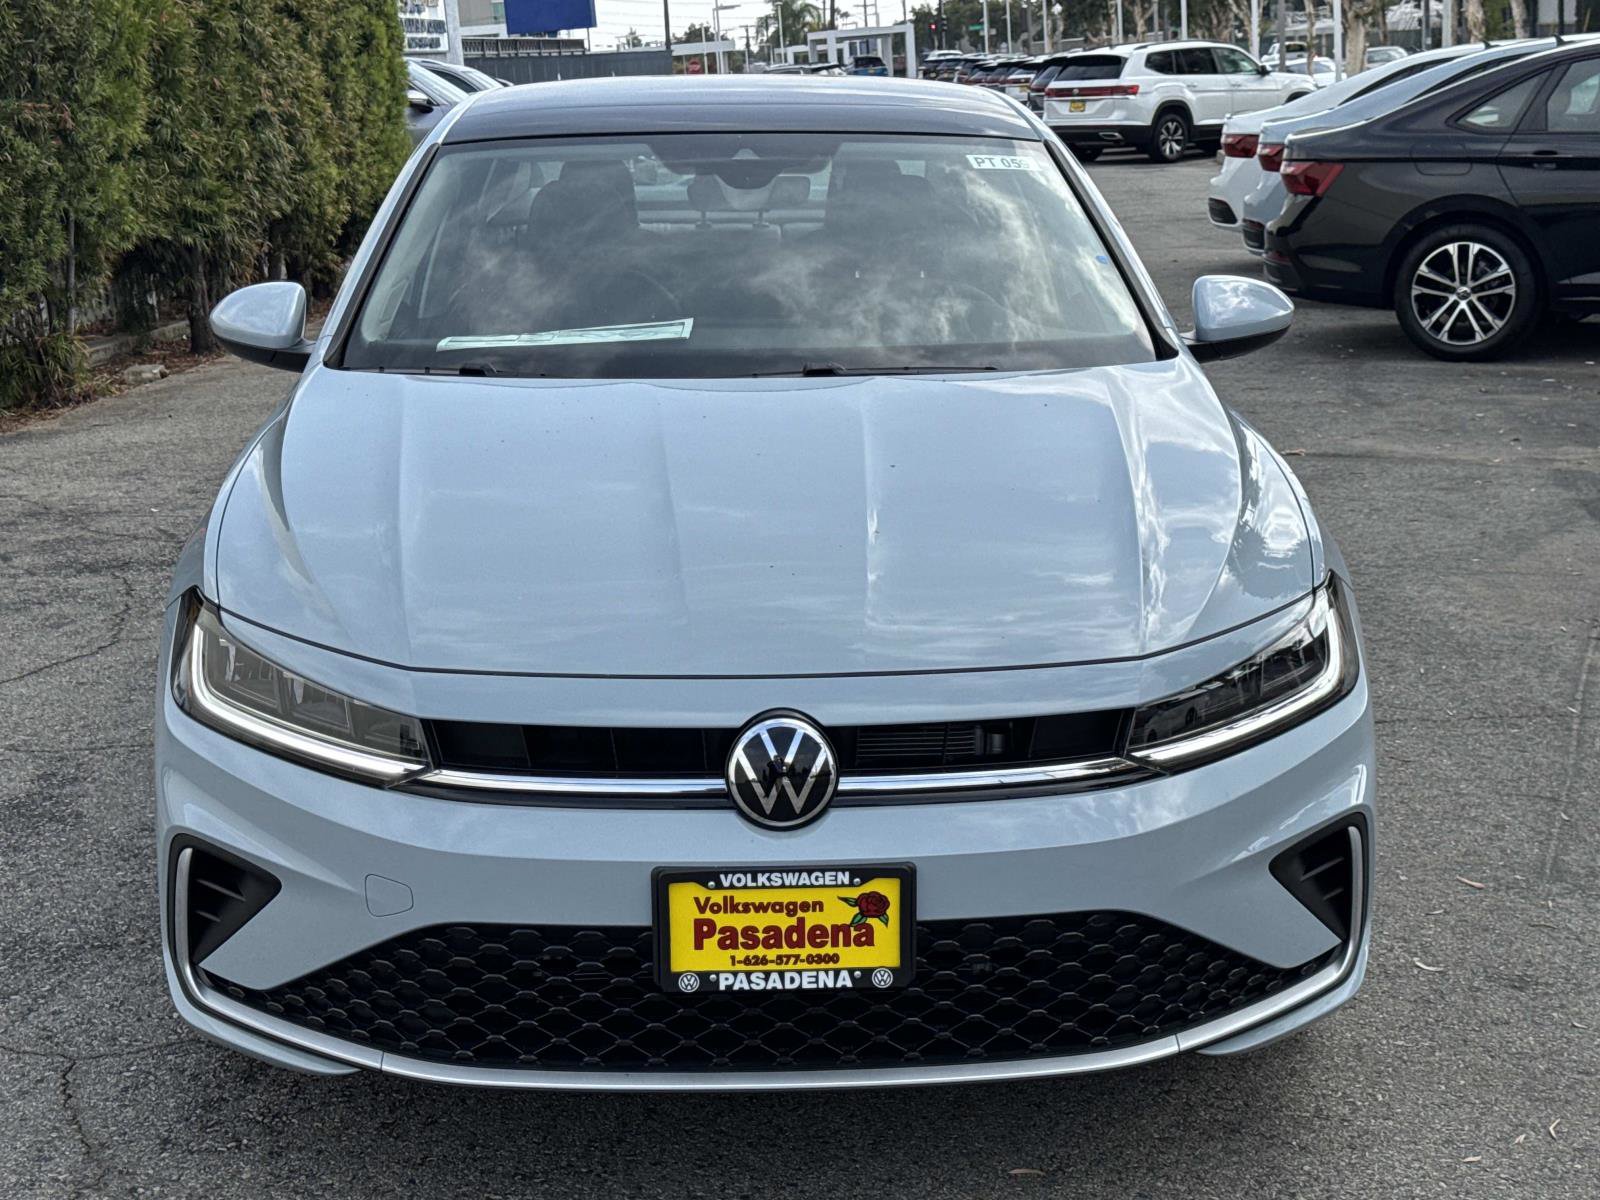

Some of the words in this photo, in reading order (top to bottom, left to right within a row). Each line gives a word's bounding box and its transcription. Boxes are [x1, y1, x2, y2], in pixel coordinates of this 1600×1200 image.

[973, 156, 996, 168] PT
[720, 871, 850, 888] VOLKSWAGEN
[693, 895, 824, 917] Volkswagen
[693, 917, 875, 951] Pasadena
[730, 953, 840, 966] 1-626-577-0300
[718, 970, 853, 990] PASADENA
